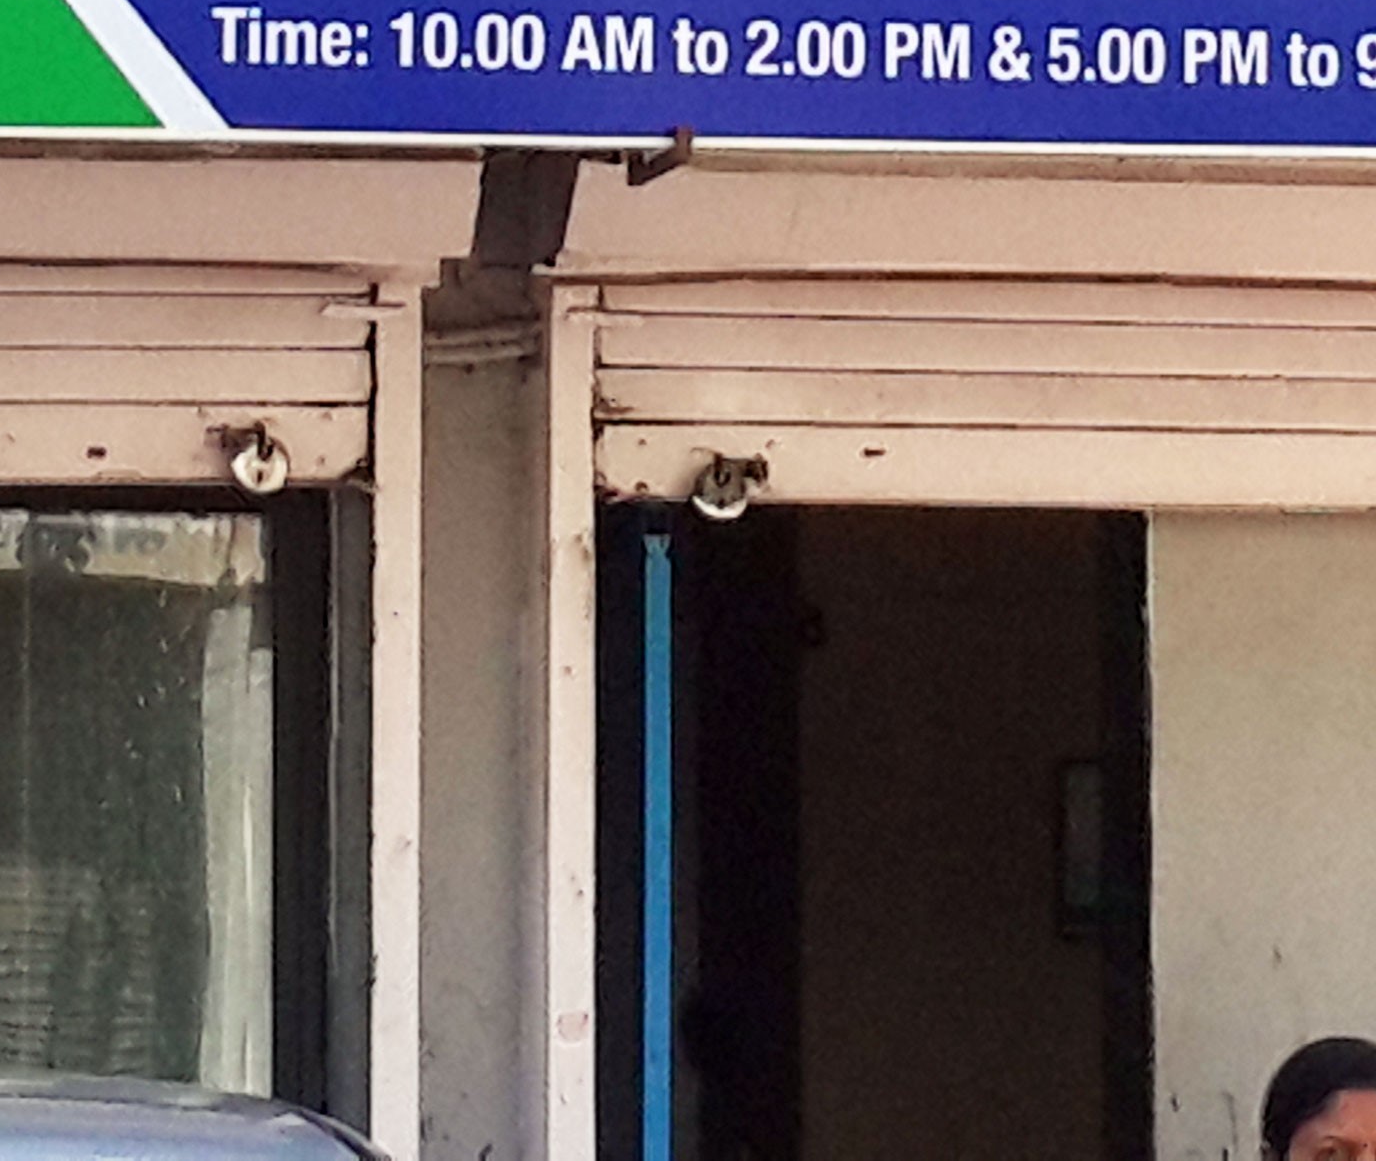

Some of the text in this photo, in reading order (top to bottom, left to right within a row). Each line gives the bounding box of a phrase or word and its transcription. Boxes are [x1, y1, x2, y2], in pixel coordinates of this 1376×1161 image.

[212, 8, 369, 68] Time:
[390, 13, 545, 70] 10.00
[561, 16, 654, 73] AM
[672, 19, 729, 76] to
[745, 21, 866, 78] 2.00
[885, 23, 970, 80] PM
[988, 26, 1030, 81] &
[1048, 28, 1166, 85] 5.00
[1184, 30, 1268, 86] PM
[1285, 33, 1339, 88] to
